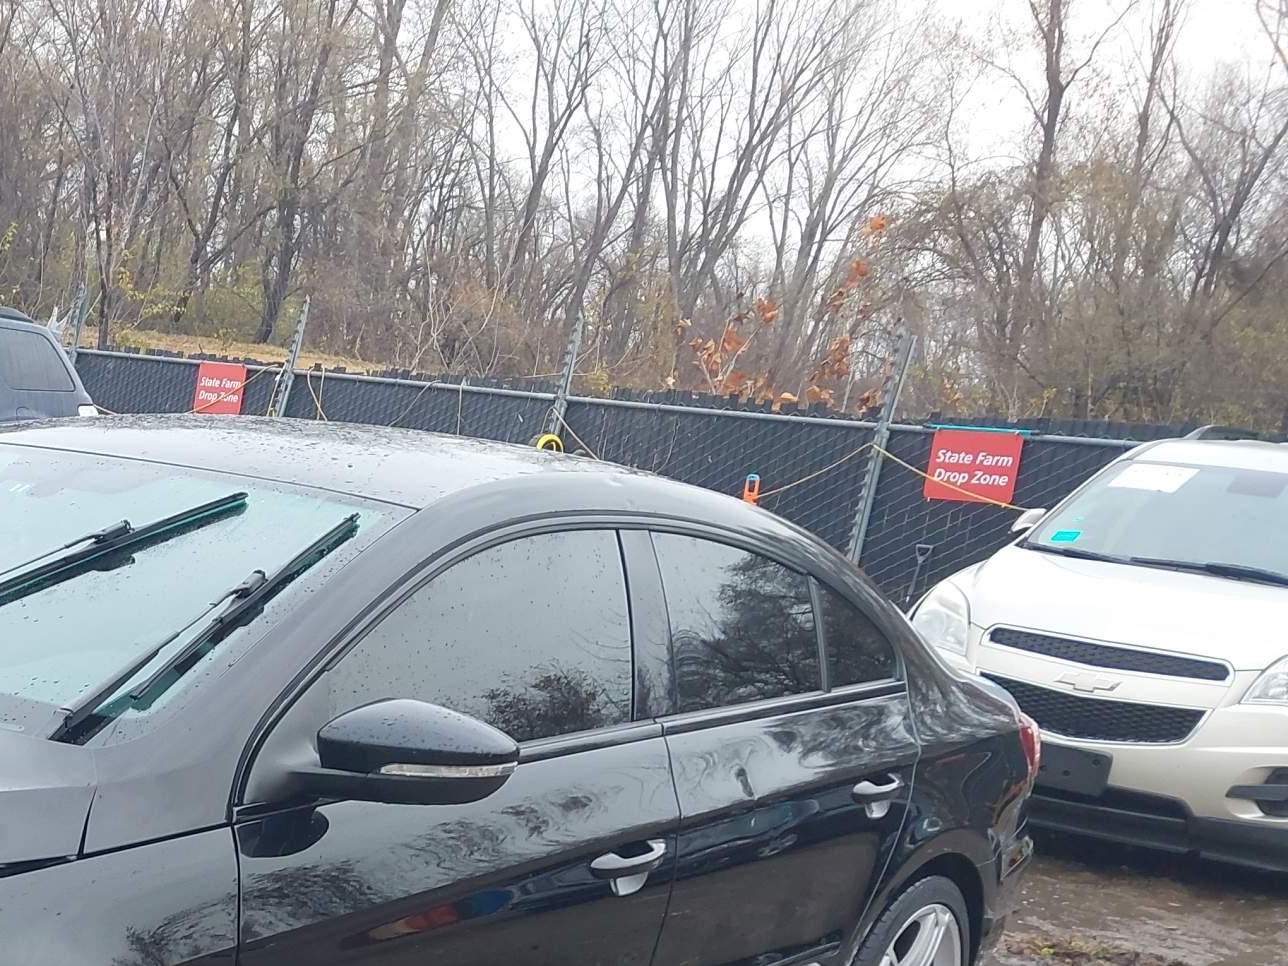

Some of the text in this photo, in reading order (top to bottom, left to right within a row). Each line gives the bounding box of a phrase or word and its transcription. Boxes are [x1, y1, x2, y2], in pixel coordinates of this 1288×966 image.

[200, 376, 241, 389] State Farm
[198, 390, 218, 402] Drop
[935, 449, 1013, 467] State Farm
[933, 468, 1009, 486] Drop Zone
